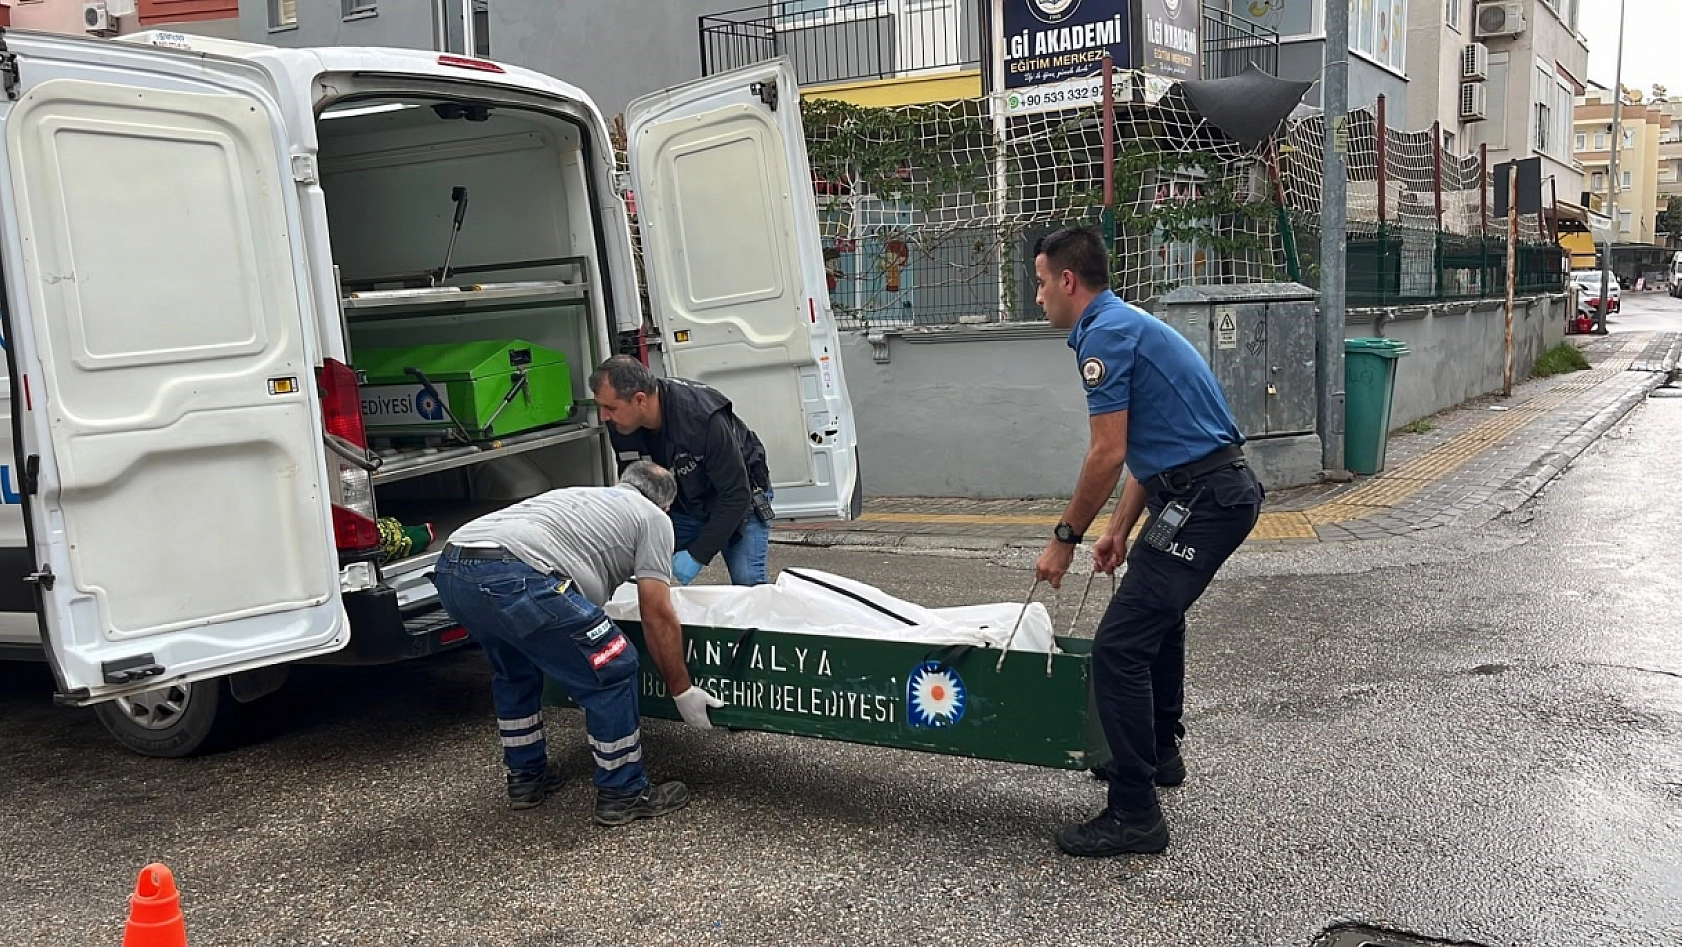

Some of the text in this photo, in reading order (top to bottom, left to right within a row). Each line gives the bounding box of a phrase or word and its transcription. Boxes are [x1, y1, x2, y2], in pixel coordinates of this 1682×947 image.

[1003, 13, 1121, 60] LGİ AKADEMİ
[1010, 56, 1050, 73] EĞİTİM
[1043, 91, 1064, 104] 533
[1067, 88, 1088, 101] 332
[770, 682, 897, 723] BELEDİYESİ
